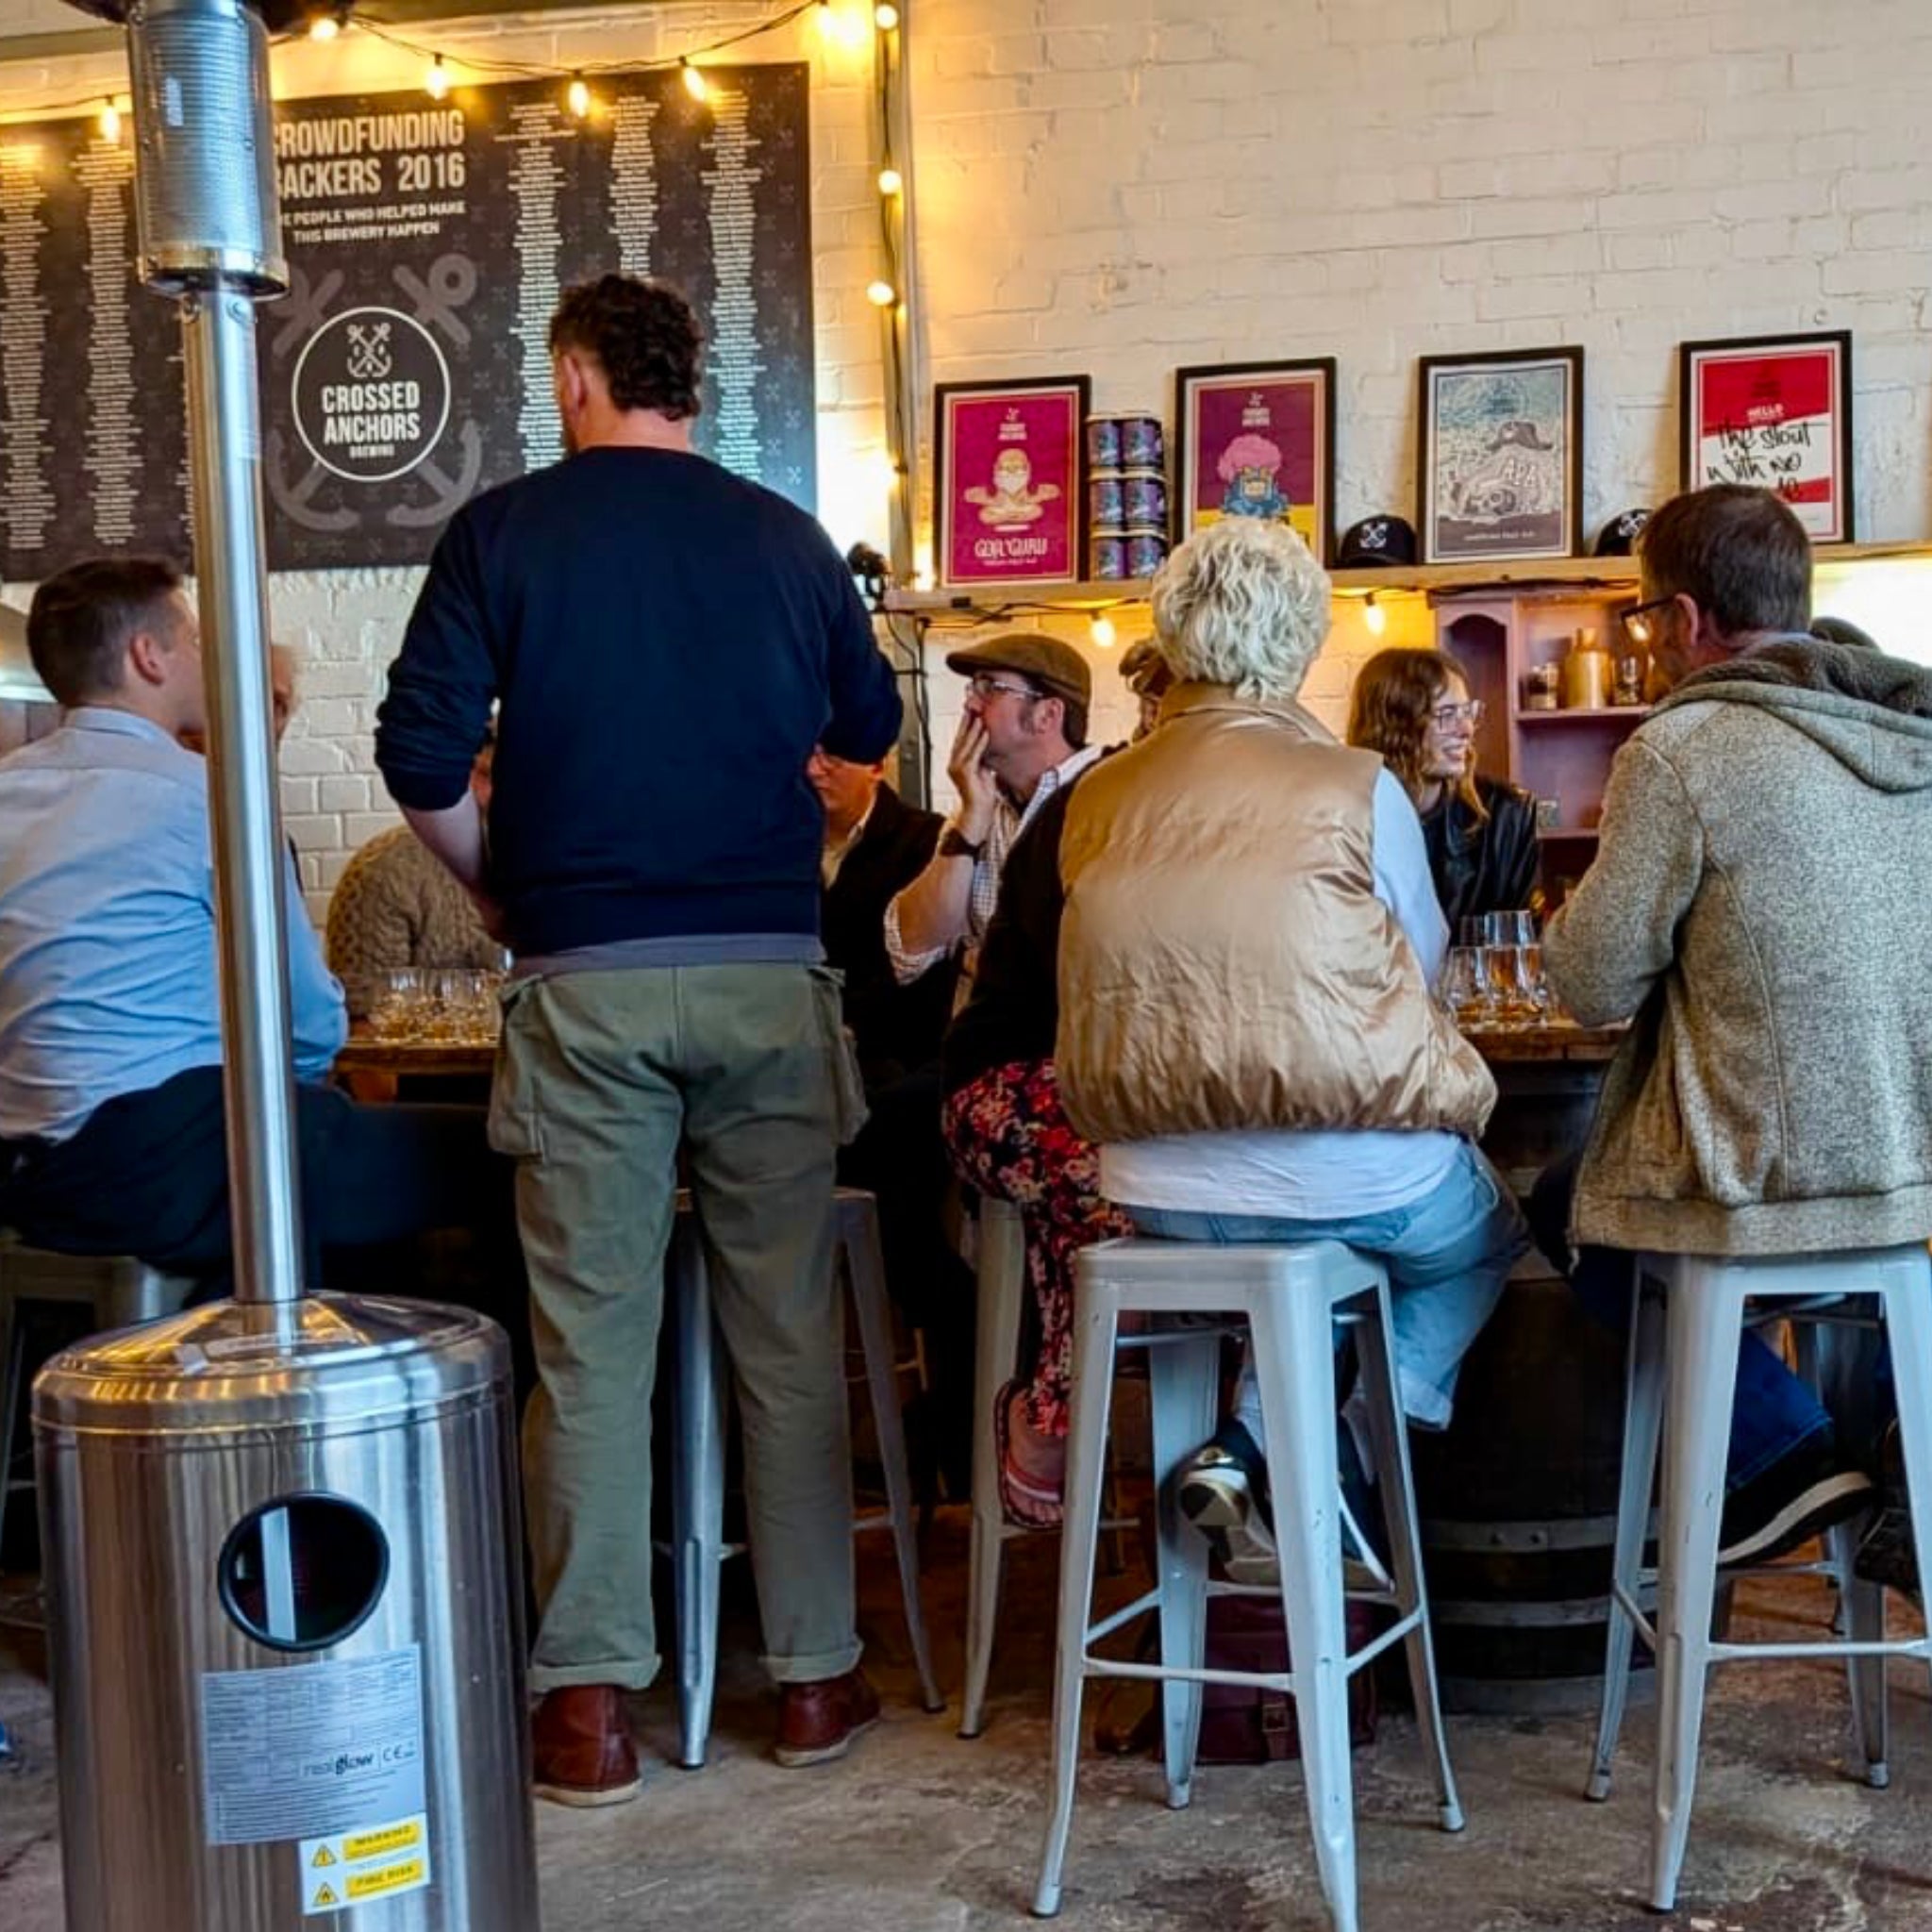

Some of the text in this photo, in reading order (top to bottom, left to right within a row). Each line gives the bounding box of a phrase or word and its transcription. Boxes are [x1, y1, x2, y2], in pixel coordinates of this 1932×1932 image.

[398, 152, 466, 192] 2016
[292, 208, 343, 225] PEOPLE
[344, 207, 375, 223] WHO
[377, 204, 426, 220] HELPED
[322, 381, 420, 413] CROSSED
[324, 412, 420, 444] ANCHORS
